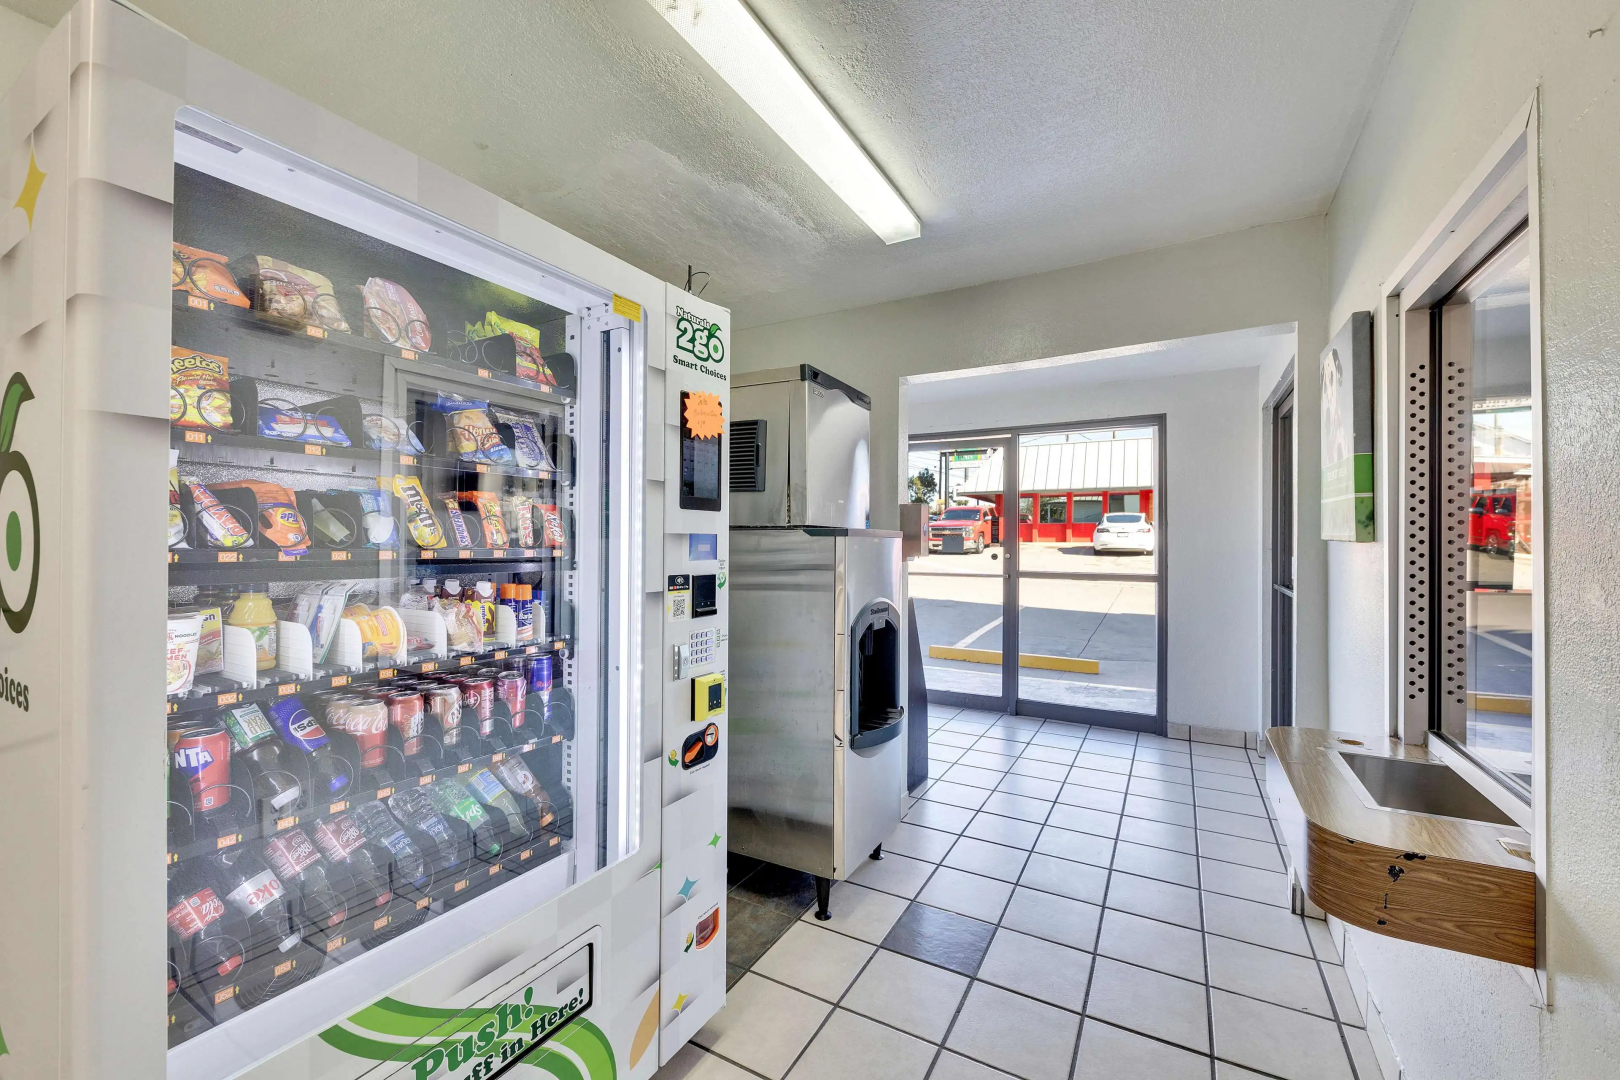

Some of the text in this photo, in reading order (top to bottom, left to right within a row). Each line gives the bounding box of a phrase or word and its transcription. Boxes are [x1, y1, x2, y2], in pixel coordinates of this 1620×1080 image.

[189, 296, 206, 307] 001
[308, 327, 321, 336] 002
[672, 354, 727, 381] Smart Choices
[187, 432, 203, 441] 011
[307, 446, 320, 454] 012
[401, 457, 412, 465] 013
[280, 512, 298, 522] Tide
[380, 670, 392, 678] 035
[334, 677, 346, 686] 034
[280, 685, 295, 694] 033
[219, 694, 235, 704] 032
[377, 788, 390, 798] 045
[278, 818, 293, 828] 043
[219, 836, 236, 847] 042
[374, 917, 386, 928] 055
[328, 939, 340, 950] 054
[276, 963, 291, 975] 053
[216, 988, 232, 1002] 052
[500, 1037, 525, 1063] in
[530, 987, 584, 1041] Here!
[410, 986, 534, 1080] Push!
